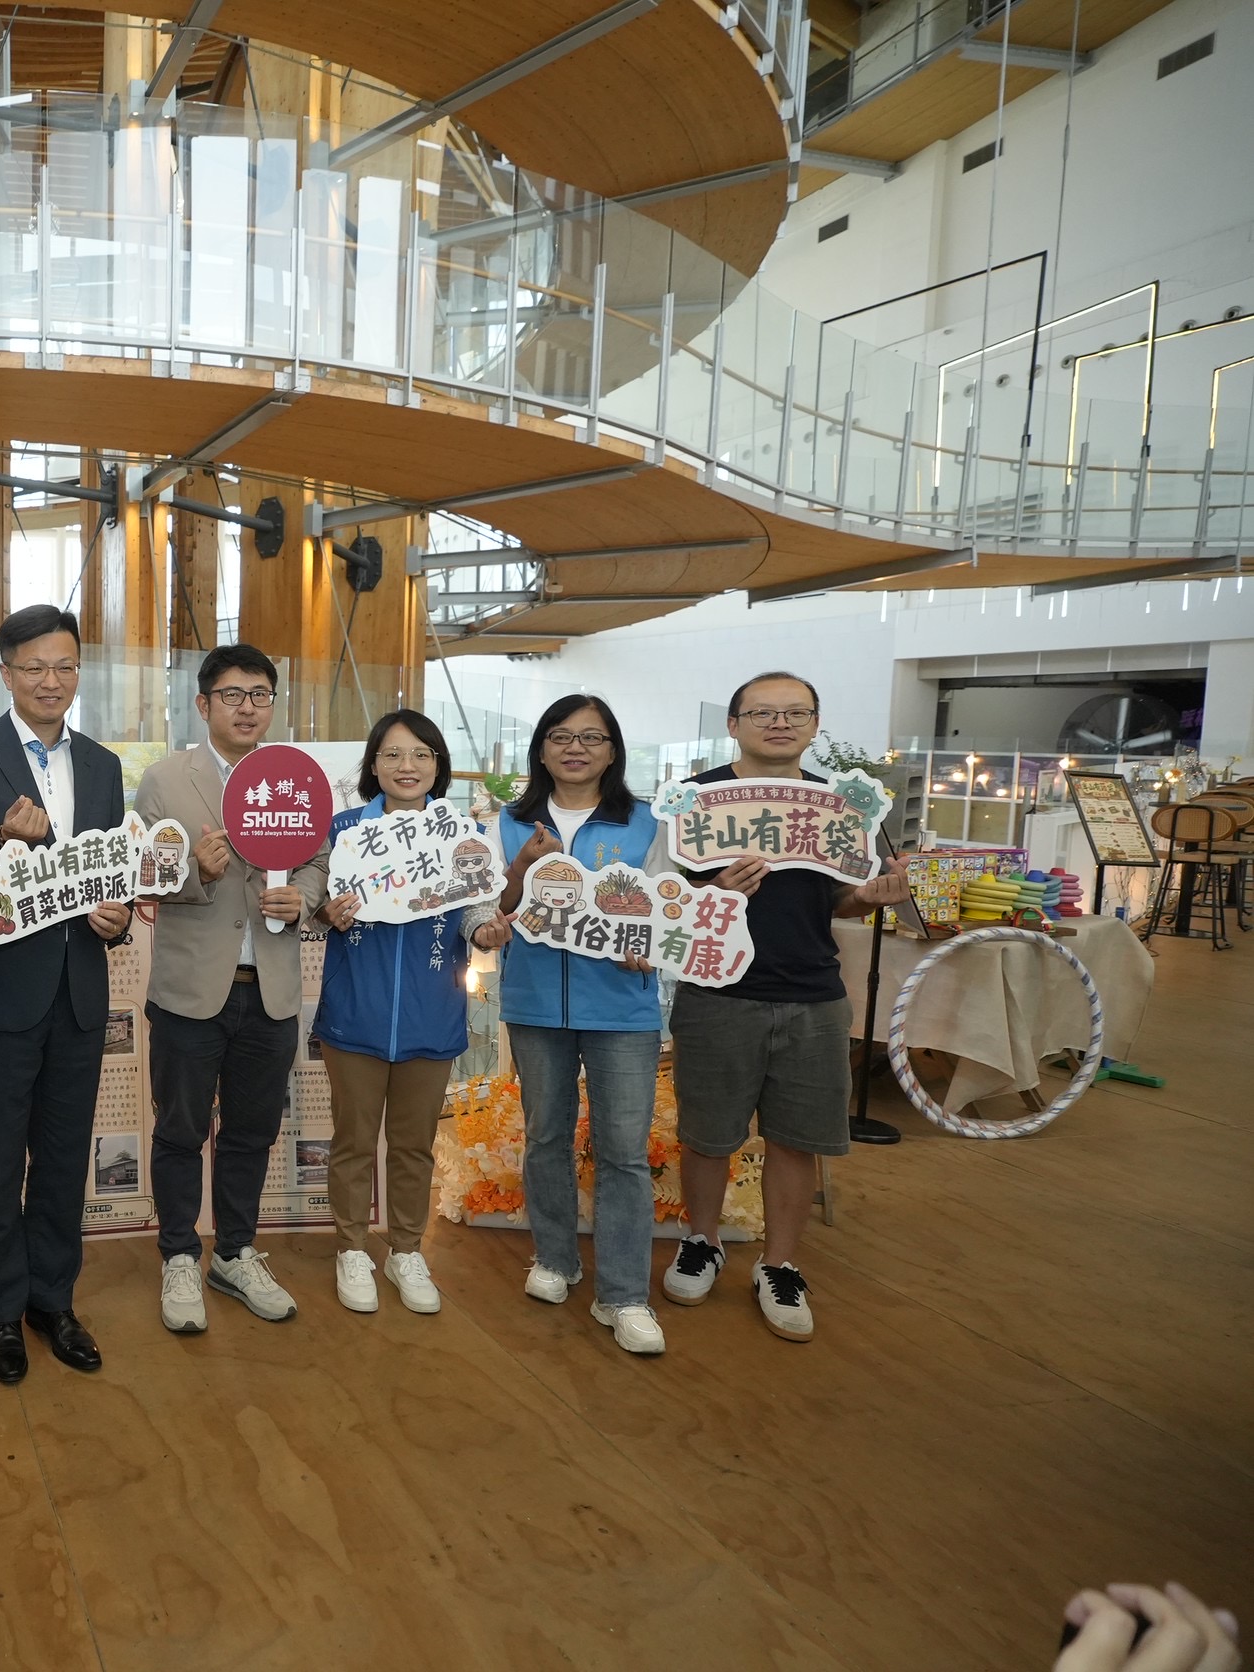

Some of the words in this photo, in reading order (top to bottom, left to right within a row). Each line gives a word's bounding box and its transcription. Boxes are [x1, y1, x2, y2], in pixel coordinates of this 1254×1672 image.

[242, 811, 313, 828] SHUTER
[681, 807, 858, 862] 半山有蔬袋
[299, 931, 328, 941] 中的生
